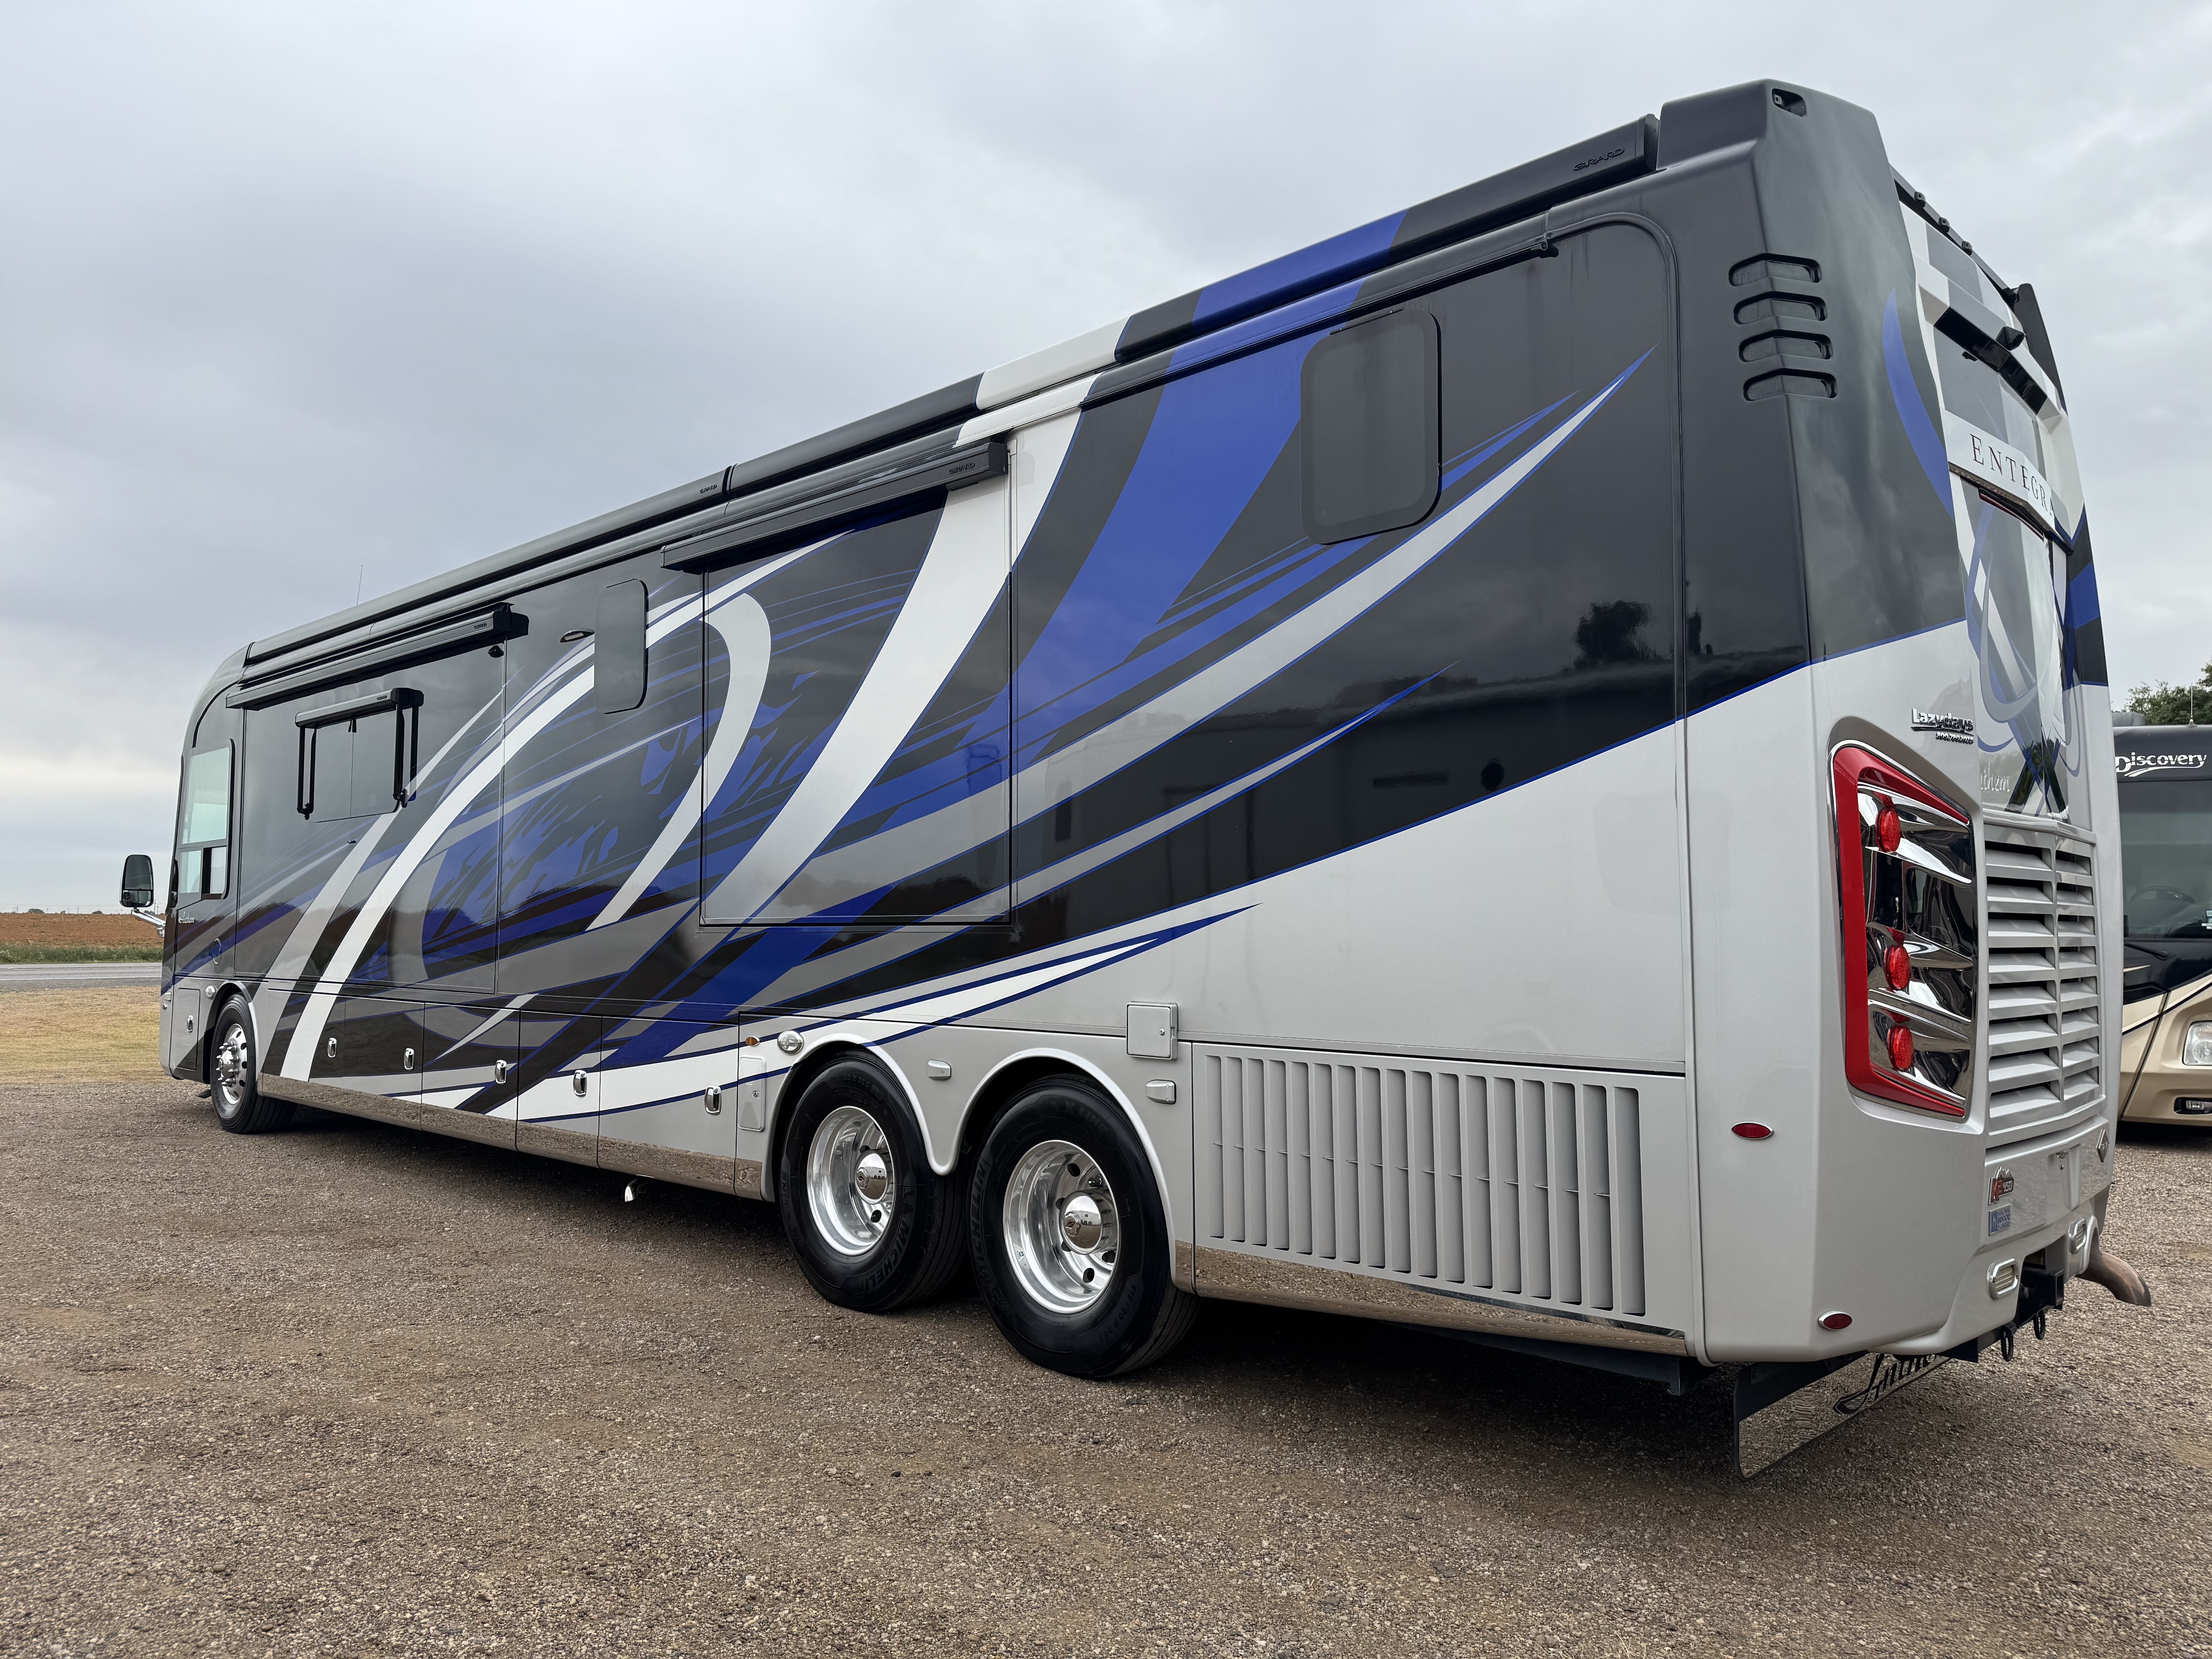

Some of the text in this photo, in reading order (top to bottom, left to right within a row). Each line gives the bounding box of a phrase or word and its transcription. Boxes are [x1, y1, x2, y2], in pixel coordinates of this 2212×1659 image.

[1970, 433, 2054, 516] ENTEGRA
[1911, 708, 1973, 732] Lazydays
[2115, 752, 2207, 774] Discovery
[970, 1162, 992, 1286] MICHELIN
